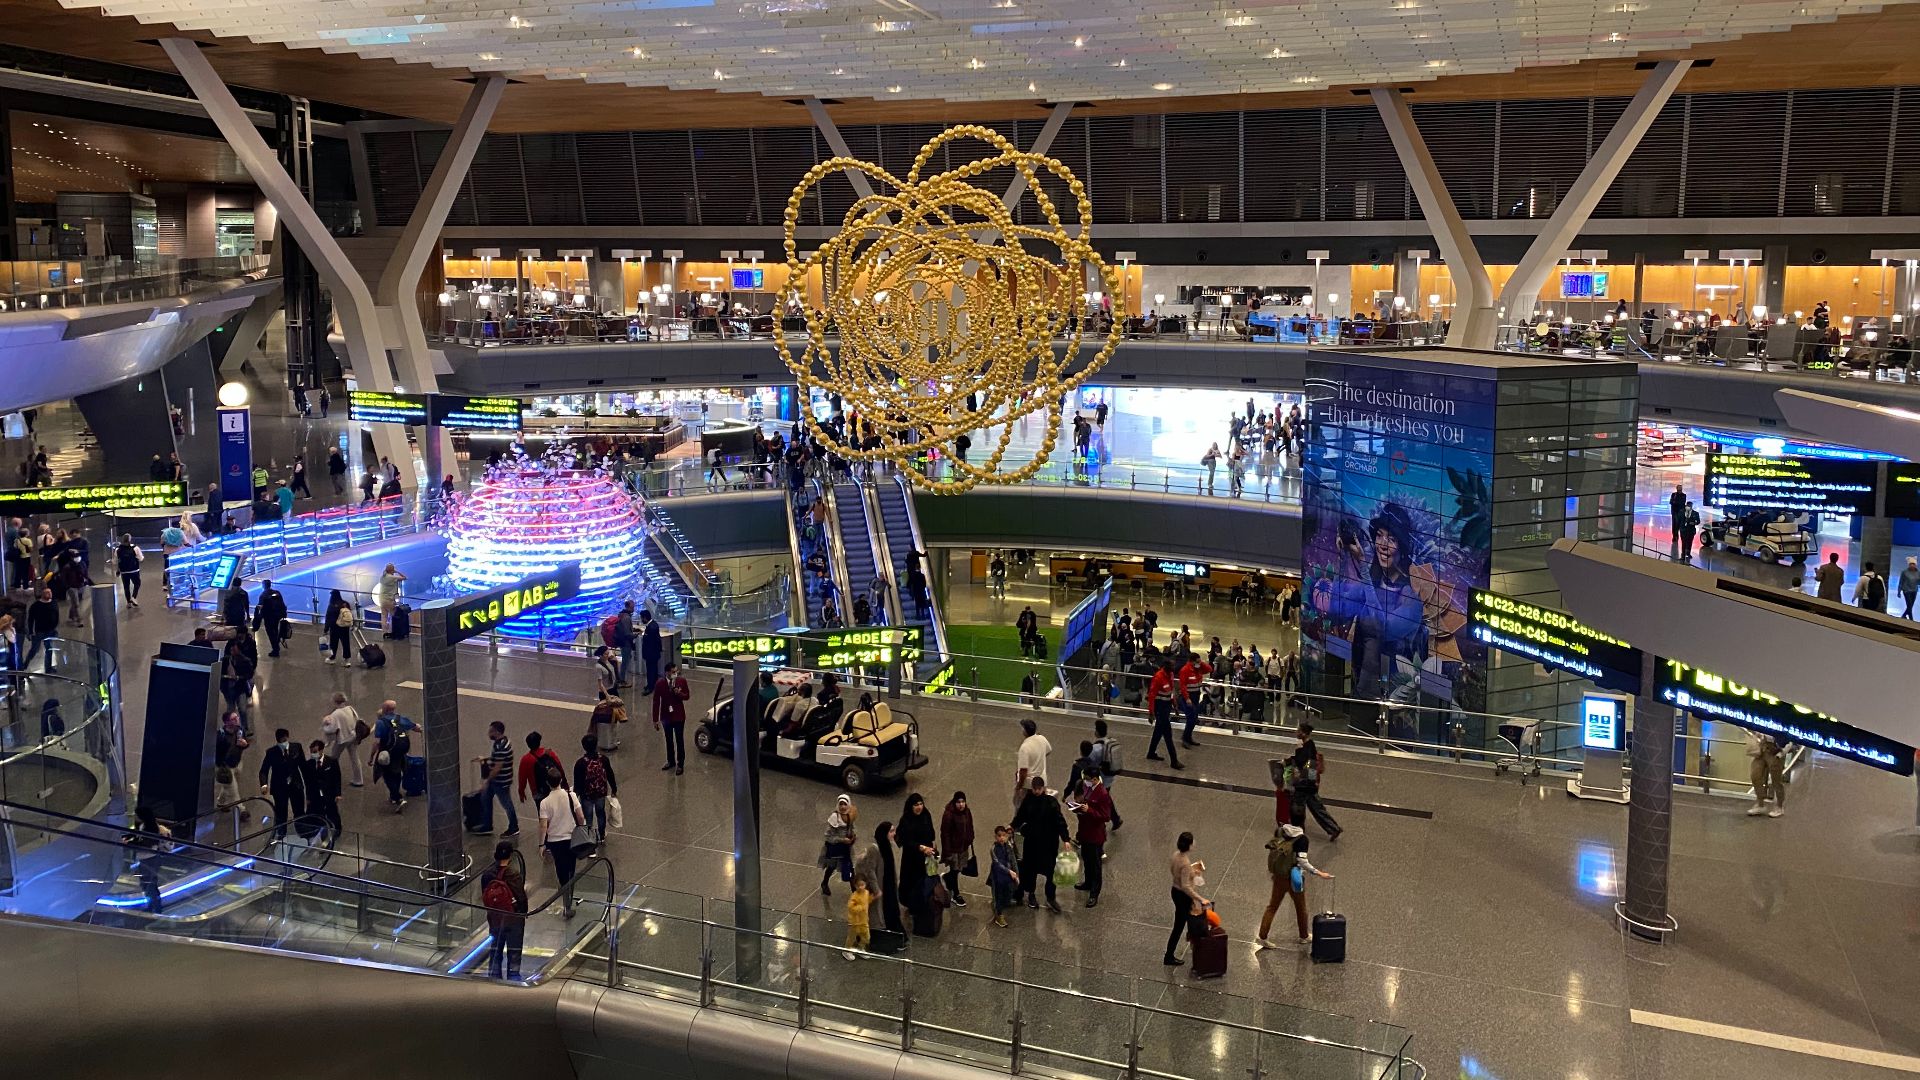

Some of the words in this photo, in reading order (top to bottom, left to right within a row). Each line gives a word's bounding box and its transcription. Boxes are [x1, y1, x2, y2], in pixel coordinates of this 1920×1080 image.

[1336, 380, 1363, 402] The
[1366, 385, 1456, 416] destination
[1327, 403, 1355, 426] that
[1360, 410, 1430, 438] refreshes
[1433, 424, 1465, 444] you
[1344, 460, 1378, 474] ORCHARD
[1728, 455, 1767, 466] C18-C21
[1735, 467, 1776, 477] C30-C43
[104, 498, 153, 509] C30-C43
[521, 585, 544, 609] AB
[843, 631, 880, 645] ABDE
[1499, 618, 1548, 643] C30-C43
[1690, 698, 1722, 714] Lounges
[1723, 706, 1745, 721] North
[1745, 712, 1753, 722] &
[1753, 716, 1784, 732] Garden
[1787, 725, 1824, 746] والحديقة
[1824, 735, 1851, 752] شمال
[1857, 745, 1895, 765] الصالات
